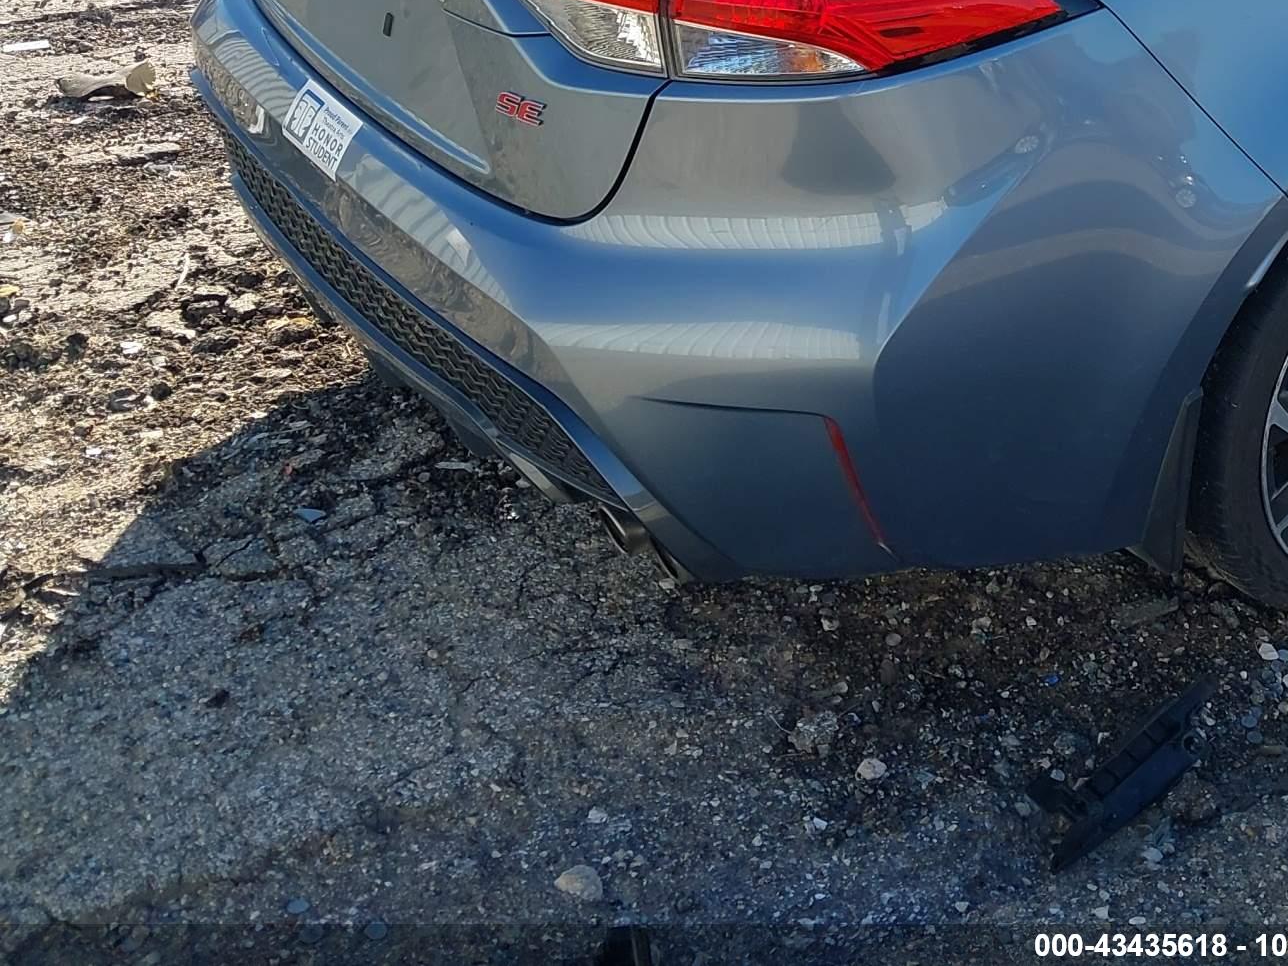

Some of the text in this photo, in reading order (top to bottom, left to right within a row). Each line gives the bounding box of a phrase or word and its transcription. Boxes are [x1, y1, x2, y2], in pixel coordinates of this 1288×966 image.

[496, 90, 547, 126] SE
[305, 135, 338, 171] STUDENT
[311, 122, 344, 158] HONOR
